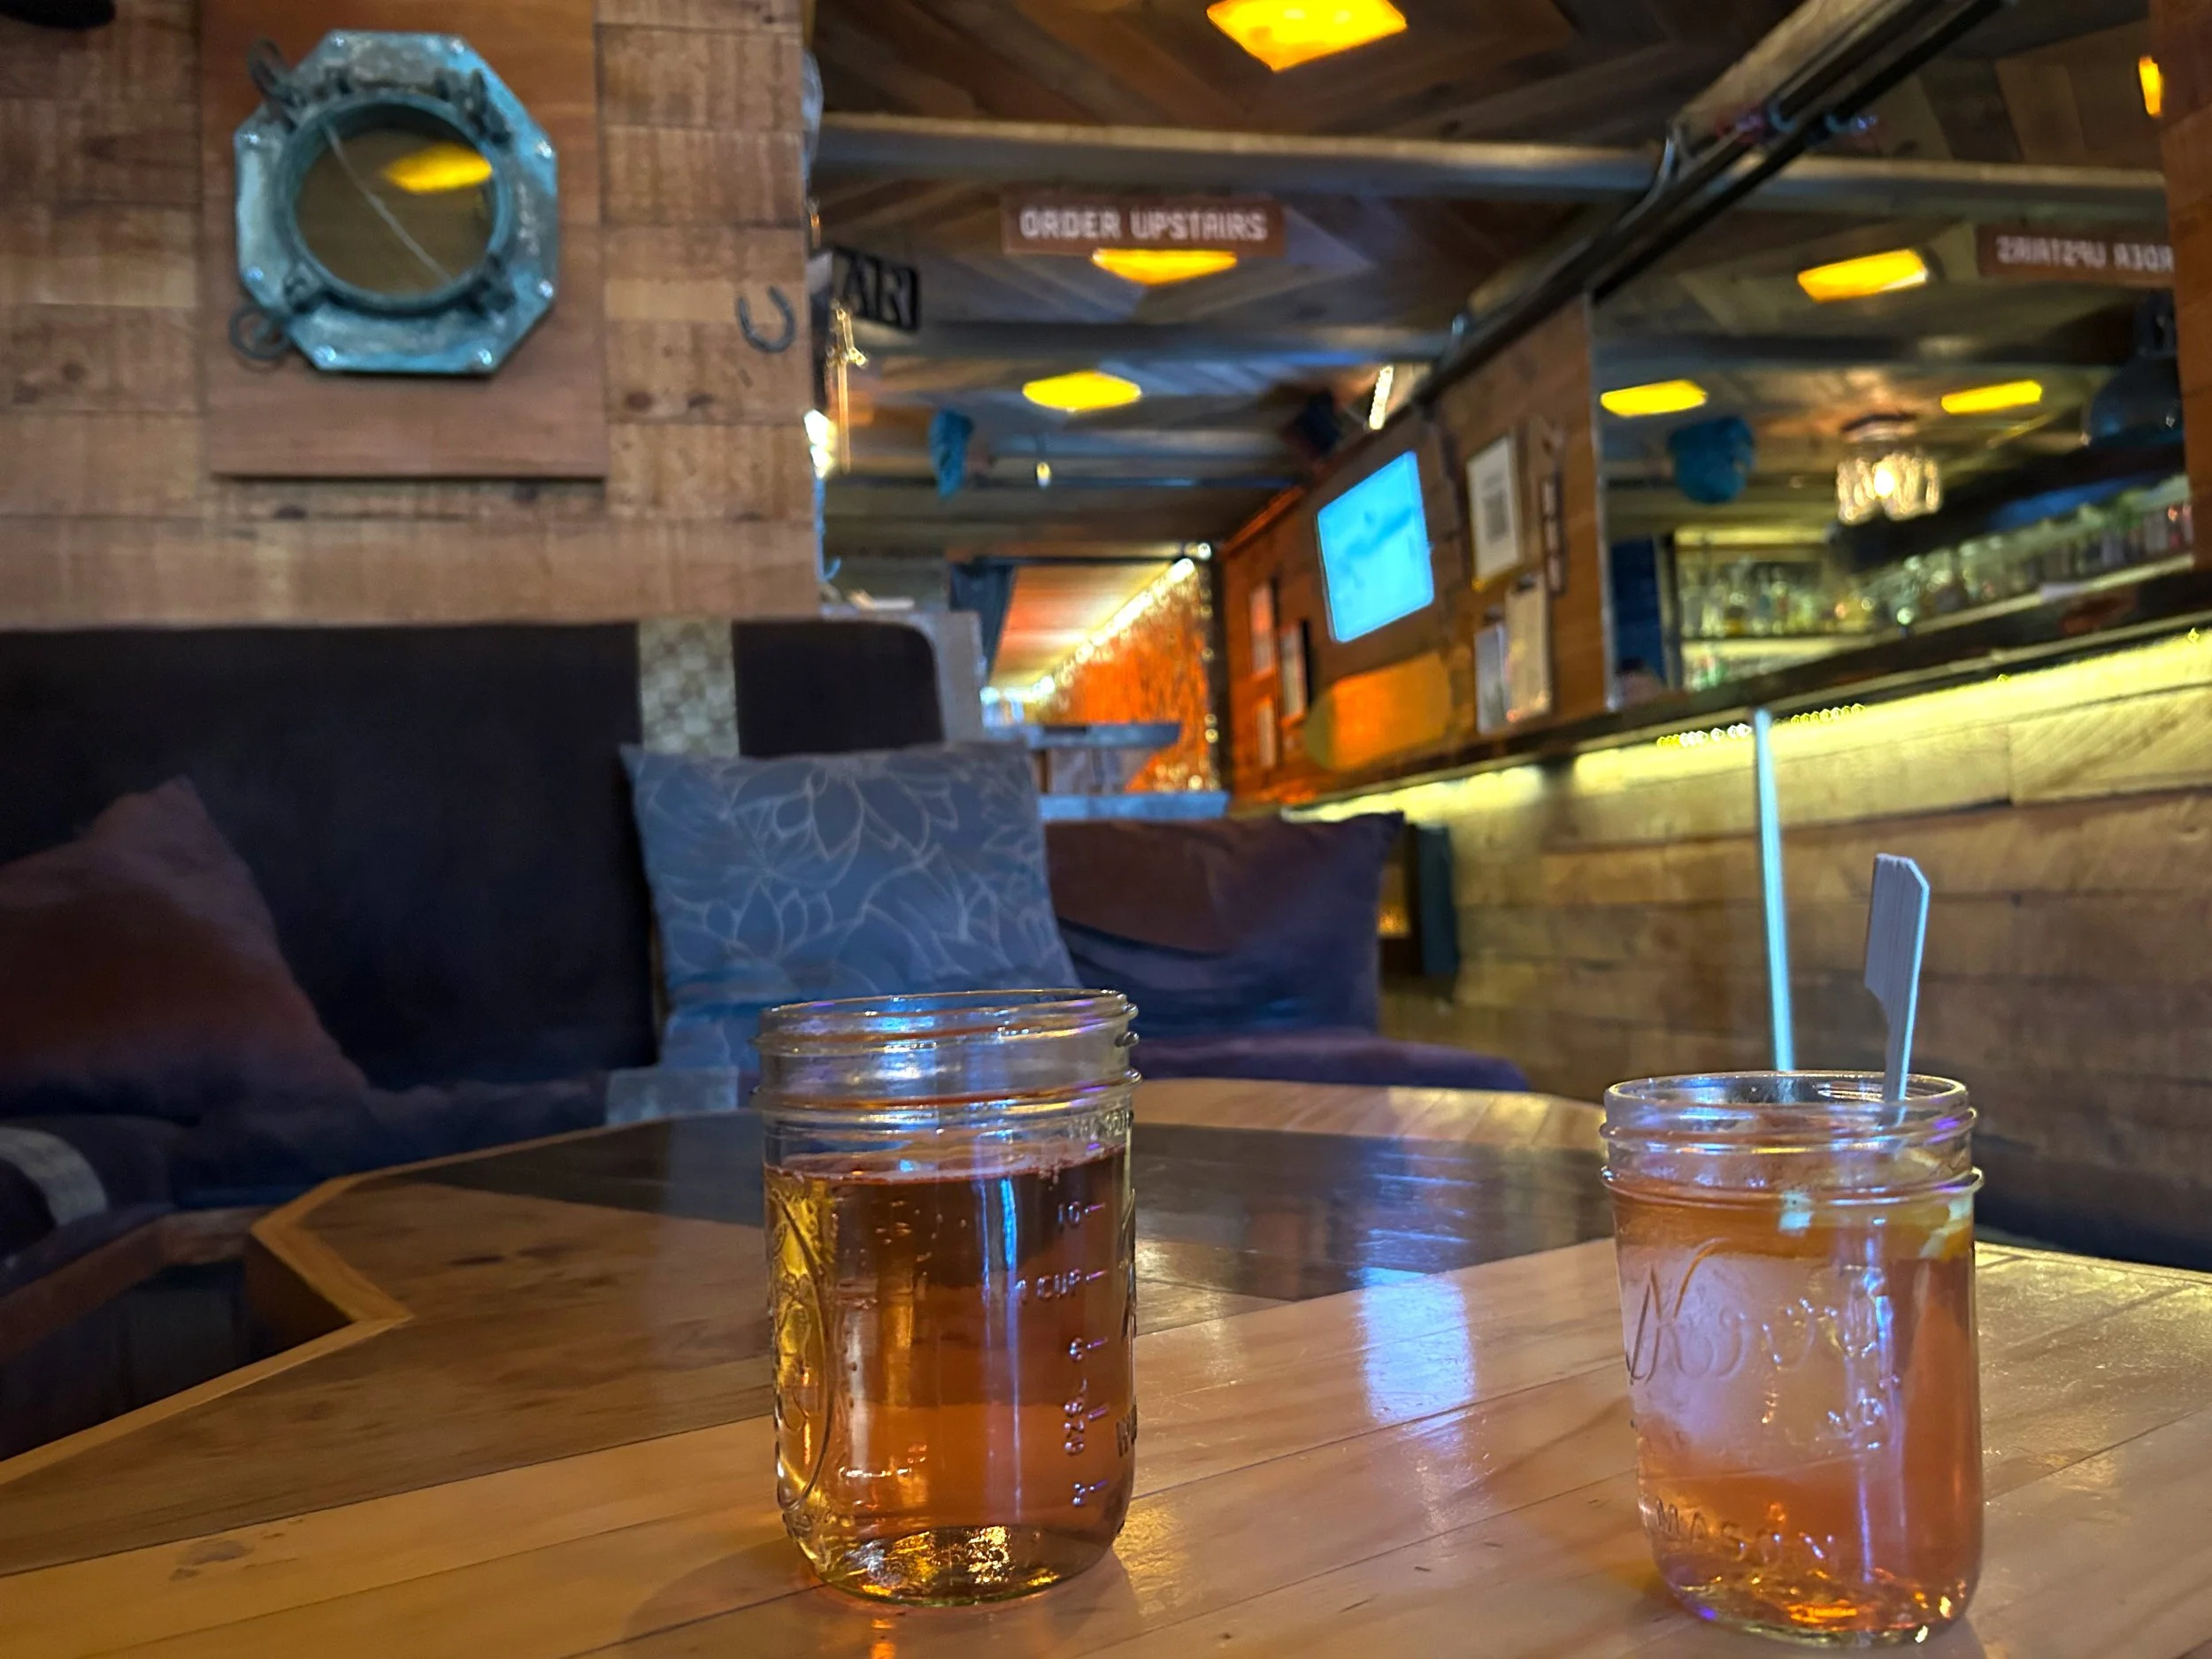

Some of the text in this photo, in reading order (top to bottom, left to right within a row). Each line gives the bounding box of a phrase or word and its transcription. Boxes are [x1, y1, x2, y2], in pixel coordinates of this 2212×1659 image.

[1019, 207, 1269, 241] ORDER UPSTAIRS
[1036, 1269, 1081, 1298] CUP
